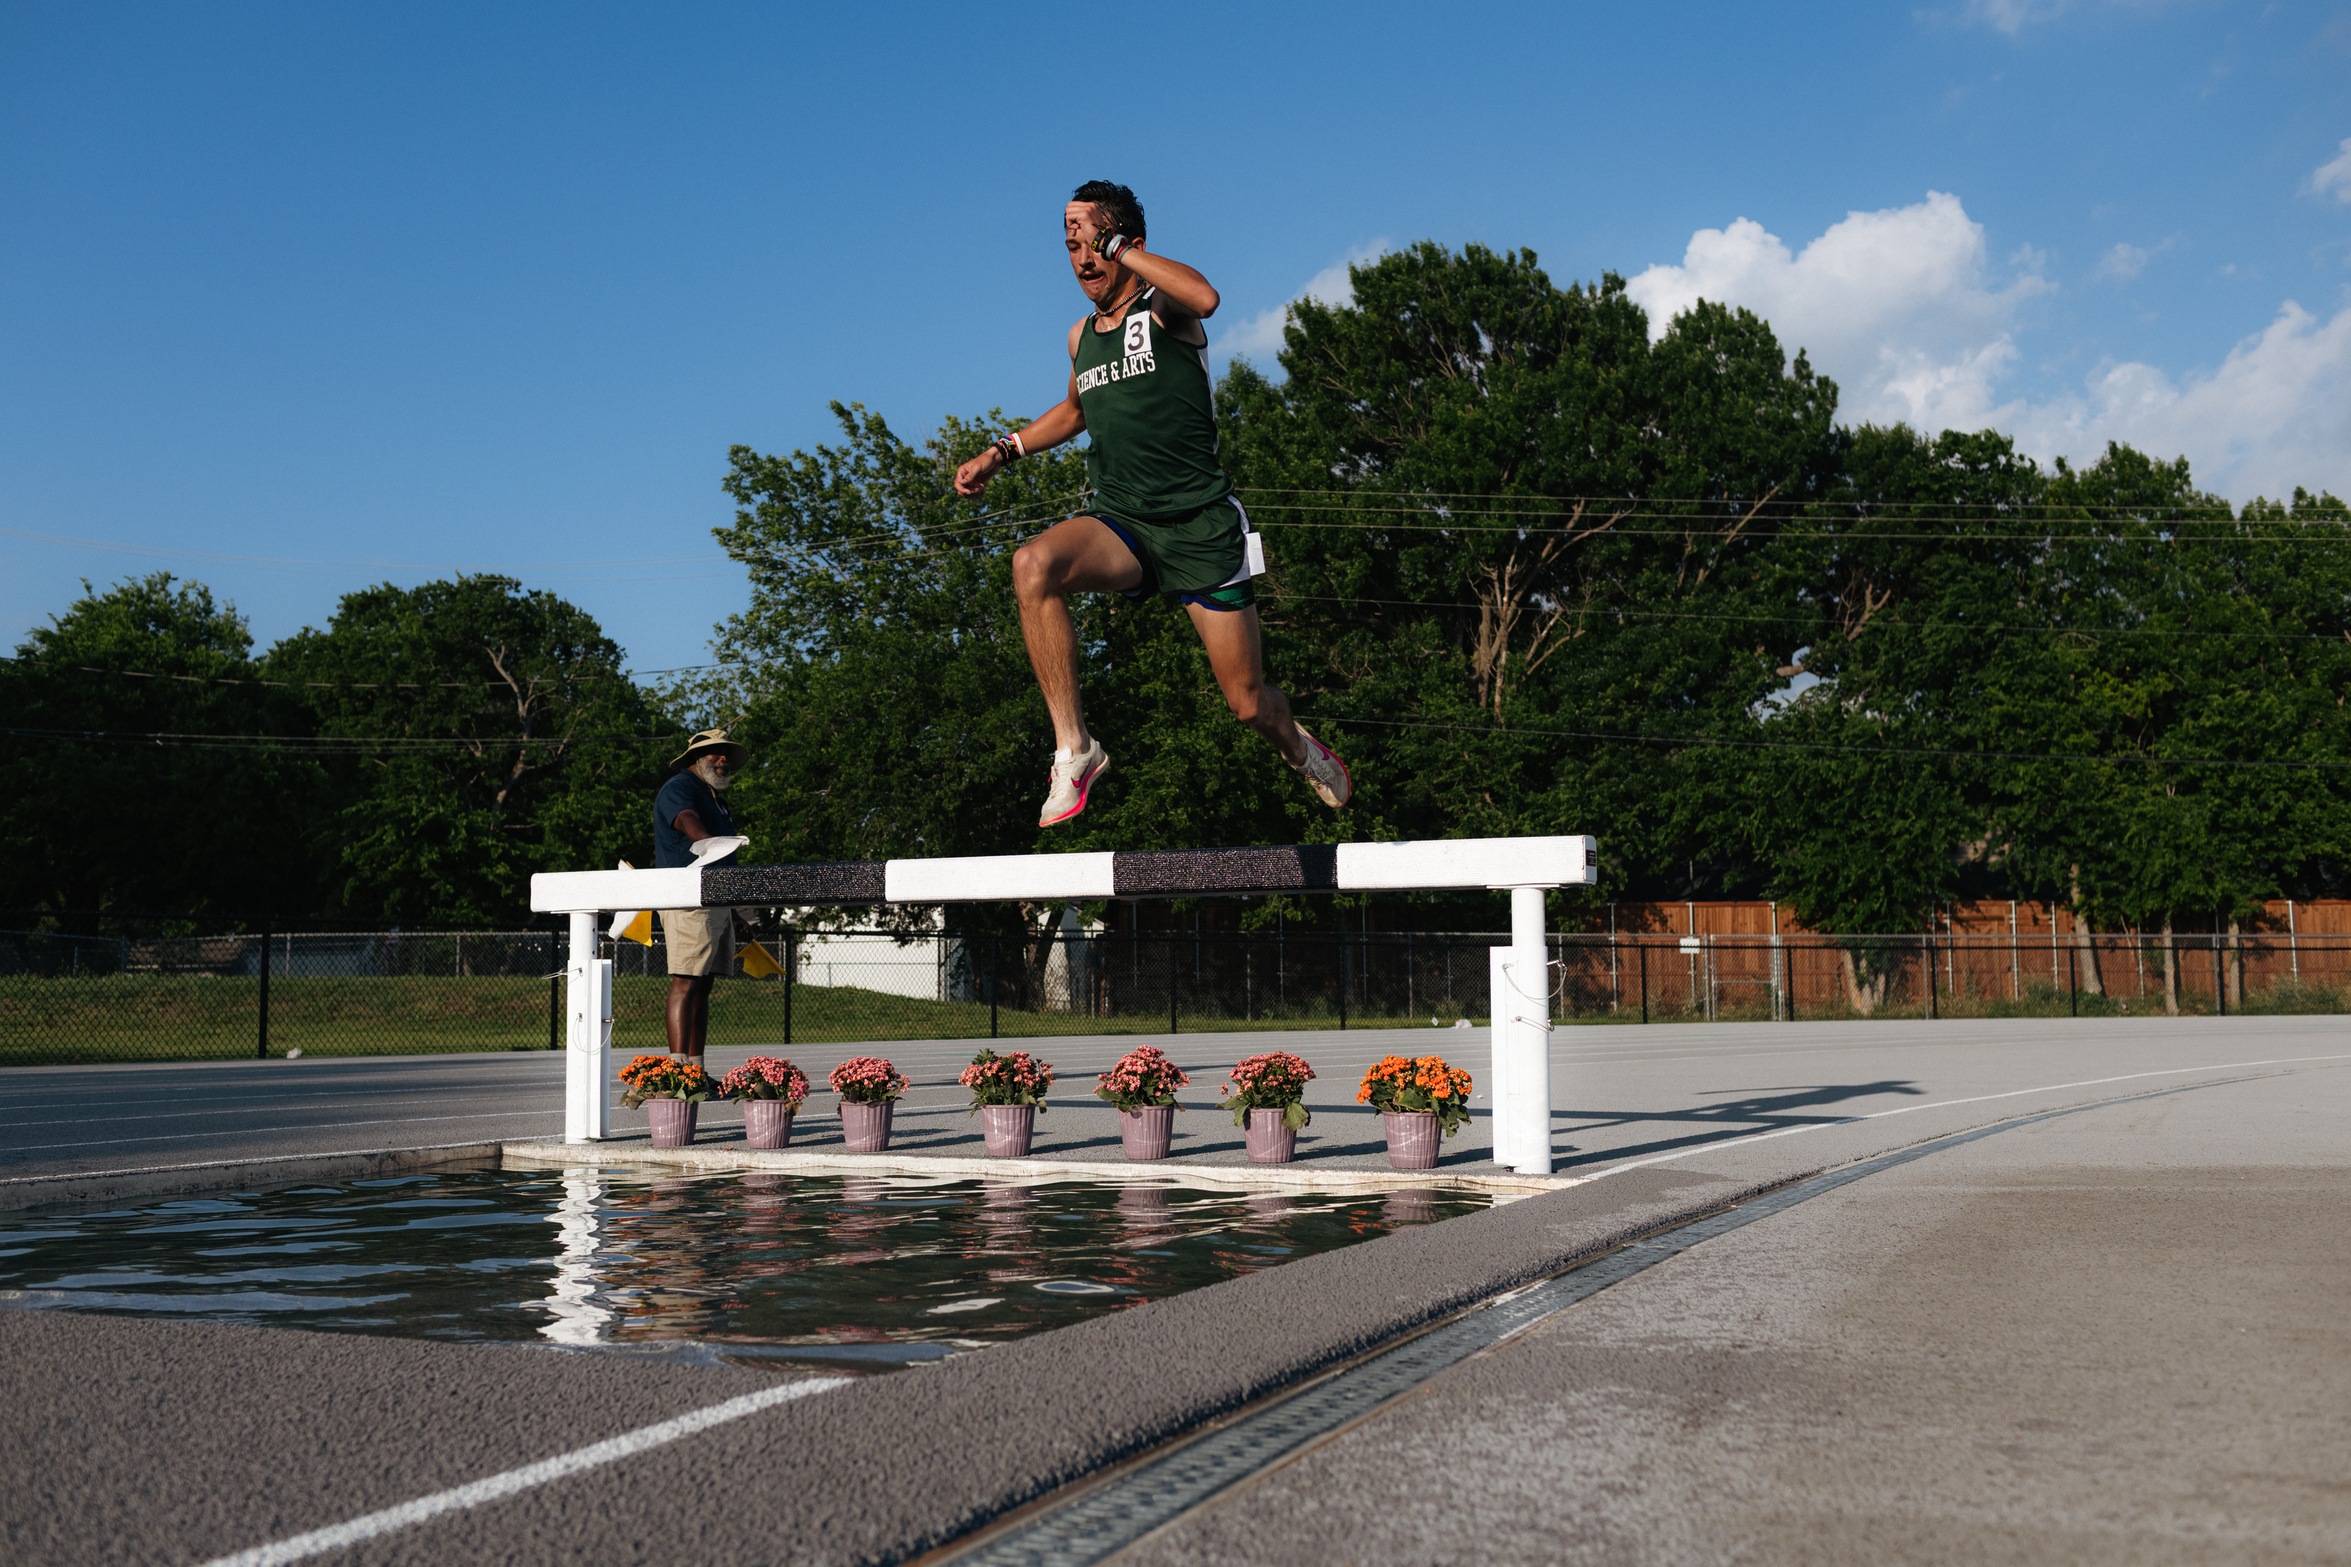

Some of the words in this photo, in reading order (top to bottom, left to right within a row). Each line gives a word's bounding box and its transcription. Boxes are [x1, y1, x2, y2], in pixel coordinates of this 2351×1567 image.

[1127, 320, 1145, 351] 3
[1110, 361, 1120, 382] &
[1122, 351, 1156, 379] ARTS
